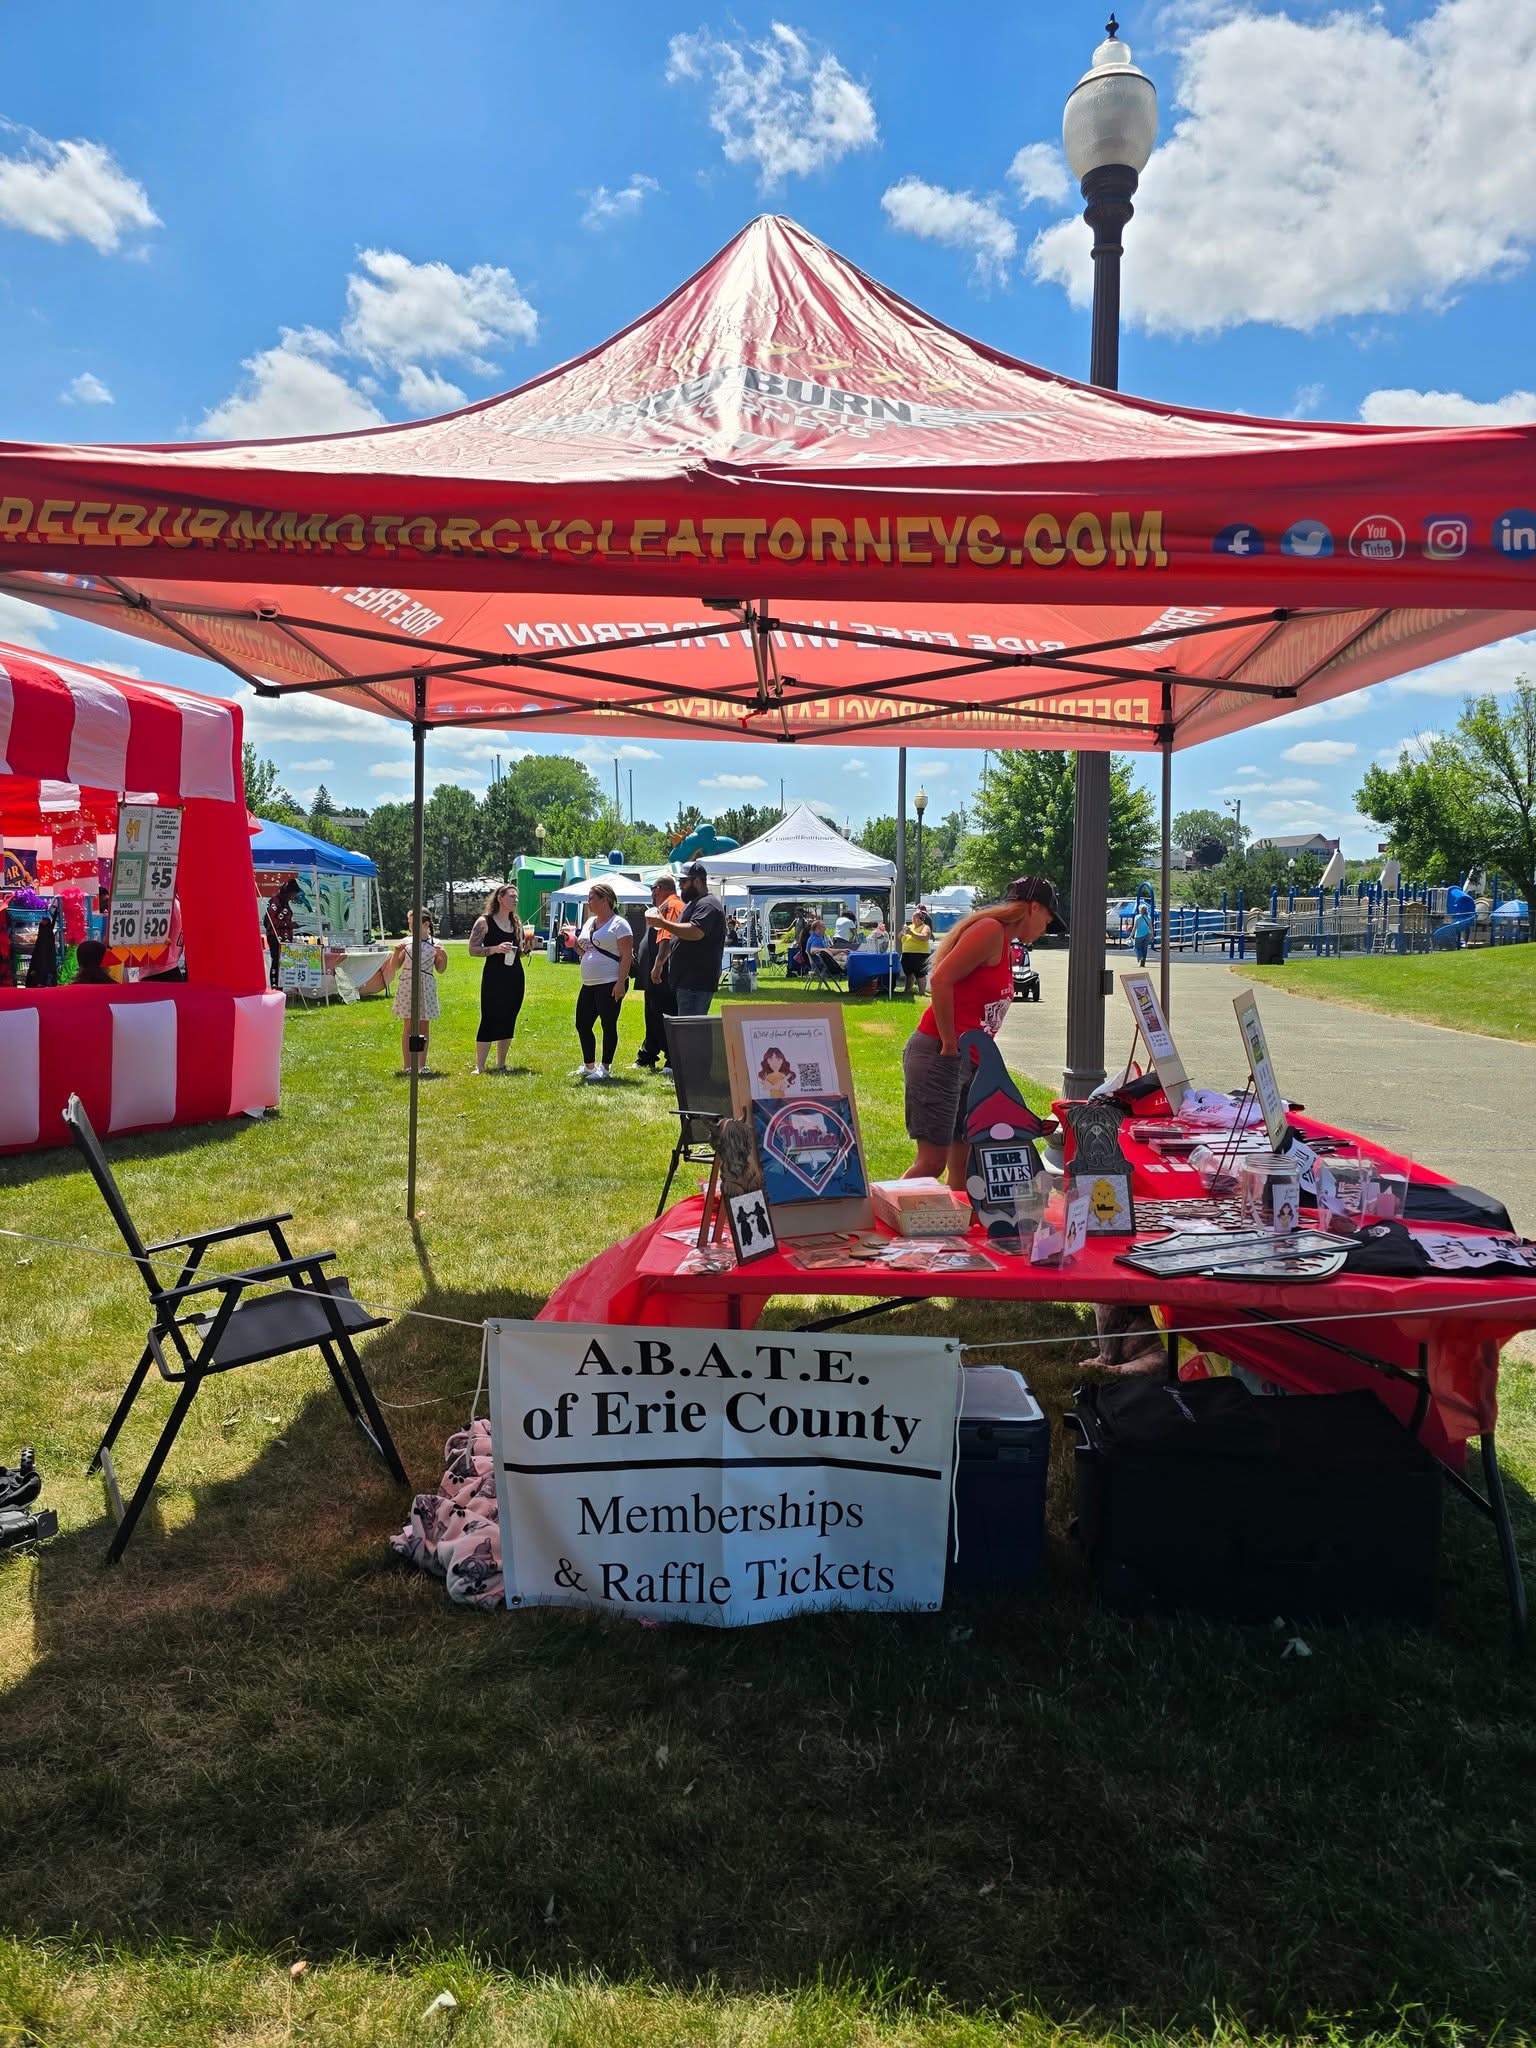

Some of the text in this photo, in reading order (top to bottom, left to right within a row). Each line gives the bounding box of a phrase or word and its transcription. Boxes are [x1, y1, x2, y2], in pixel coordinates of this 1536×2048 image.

[1367, 524, 1387, 539] You
[1364, 543, 1391, 557] Tube
[151, 867, 172, 890] $5
[764, 864, 838, 872] UnitedHealthcare
[112, 917, 135, 940] $10
[144, 917, 168, 939] $20
[778, 1124, 840, 1151] Phillies
[987, 1166, 1031, 1183] LIVES
[574, 1338, 871, 1386] A.B.A.T.E.
[522, 1389, 922, 1455] of Erie County
[576, 1490, 864, 1538] Memberships
[553, 1552, 895, 1605] & Raffle Tickets
